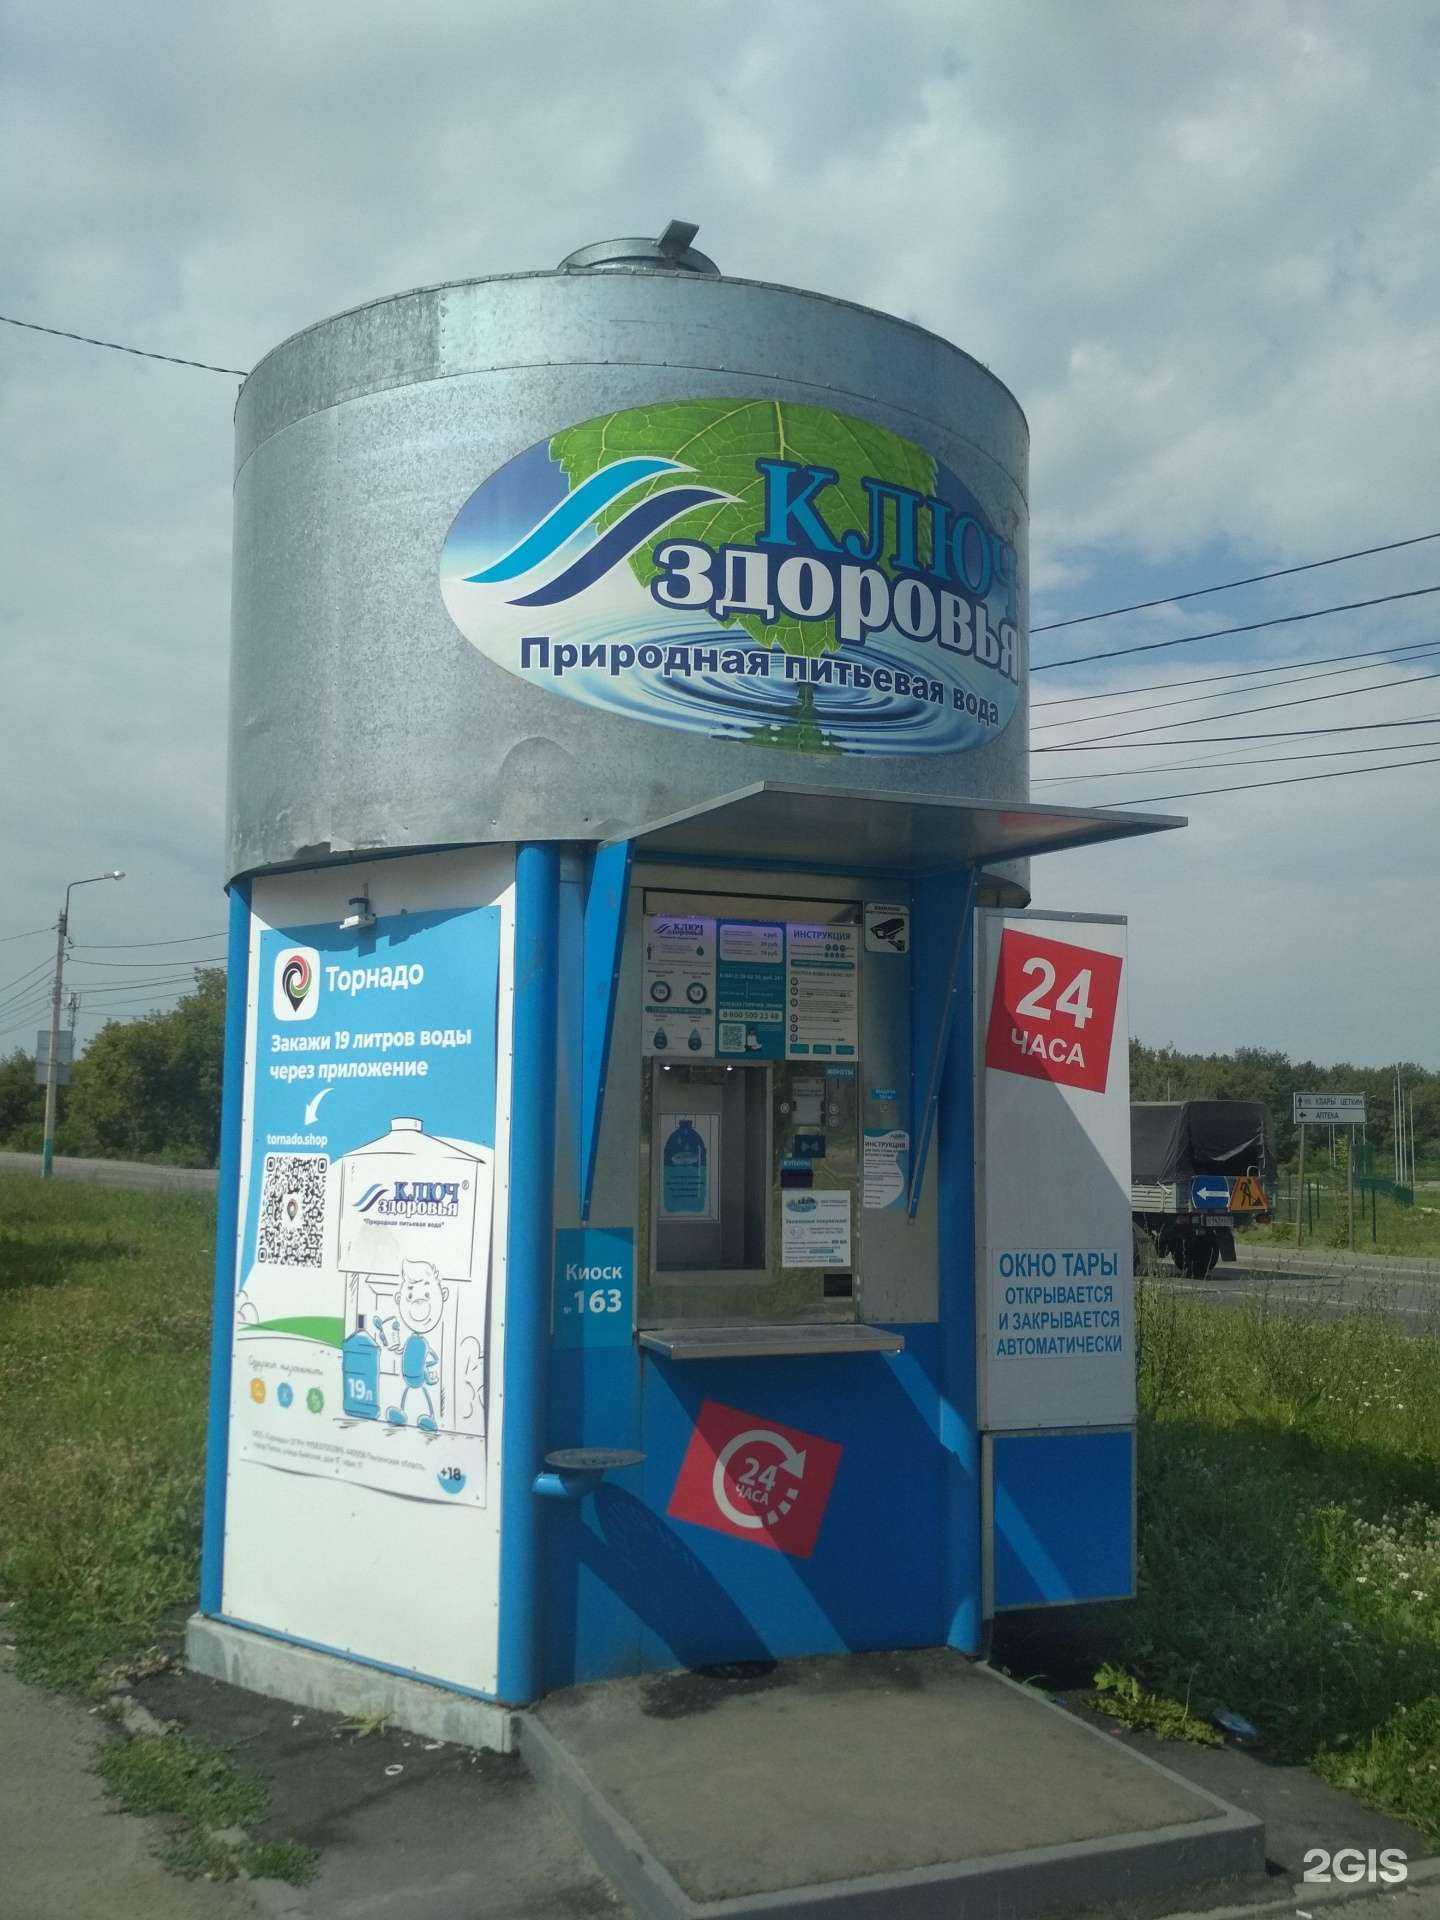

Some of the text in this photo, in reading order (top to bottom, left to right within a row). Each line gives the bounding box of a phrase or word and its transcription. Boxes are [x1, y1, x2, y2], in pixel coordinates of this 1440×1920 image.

[756, 457, 1018, 618] КЛЮЧ
[652, 539, 1020, 685] здоровья
[520, 635, 1000, 727] Природная питьевая вода
[793, 930, 851, 941] ИНСТРУКЦИЯ
[326, 962, 424, 997] Торнадо
[1015, 957, 1093, 1029] 24
[271, 1027, 472, 1053] Закажи 19 литров воды
[1011, 1028, 1086, 1068] ЧАСА
[269, 1058, 429, 1083] через приложение
[1315, 1111, 1340, 1120] АПТЕКА
[267, 1132, 328, 1148] tornado.shop
[394, 1181, 460, 1204] КЛЮЧ
[378, 1200, 459, 1218] здоровья
[566, 1264, 623, 1281] Киоск
[999, 1252, 1118, 1277] ОКНО ТАРЫ
[573, 1288, 622, 1314] 163
[1005, 1285, 1113, 1305] ОТКРЫВАЕТСЯ
[998, 1310, 1120, 1330] И ЗАКРЫВАЕТСЯ
[996, 1335, 1122, 1356] АВТОМАТИЧЕСКИ
[439, 1466, 462, 1481] +18
[738, 1457, 778, 1491] 24
[735, 1482, 769, 1505] ЧАСА
